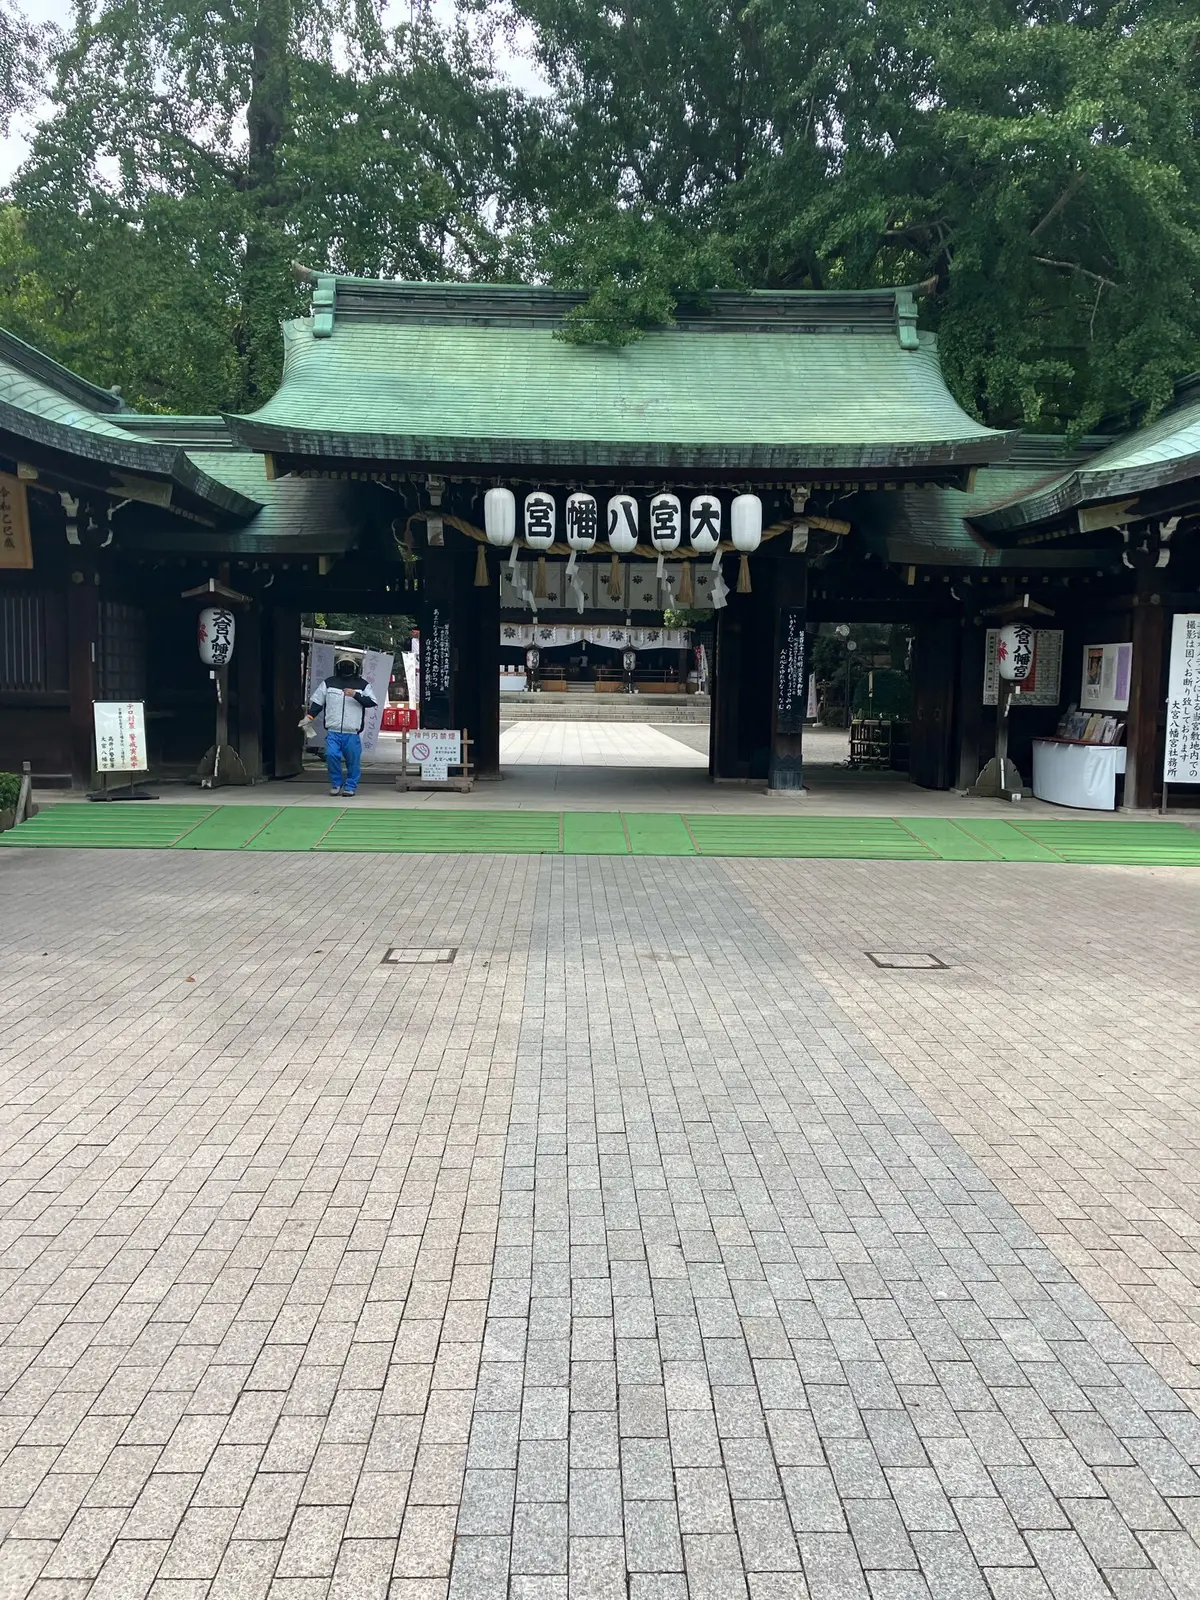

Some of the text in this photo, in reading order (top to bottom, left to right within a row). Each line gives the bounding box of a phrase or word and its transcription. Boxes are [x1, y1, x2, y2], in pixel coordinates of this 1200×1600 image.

[211, 609, 232, 664] 大宮八幡宮
[1013, 625, 1032, 678] 大宮八幡宮
[1179, 620, 1196, 762] 撮影は固くお断り致しております
[1167, 700, 1181, 777] 大宮八幡宮社務所
